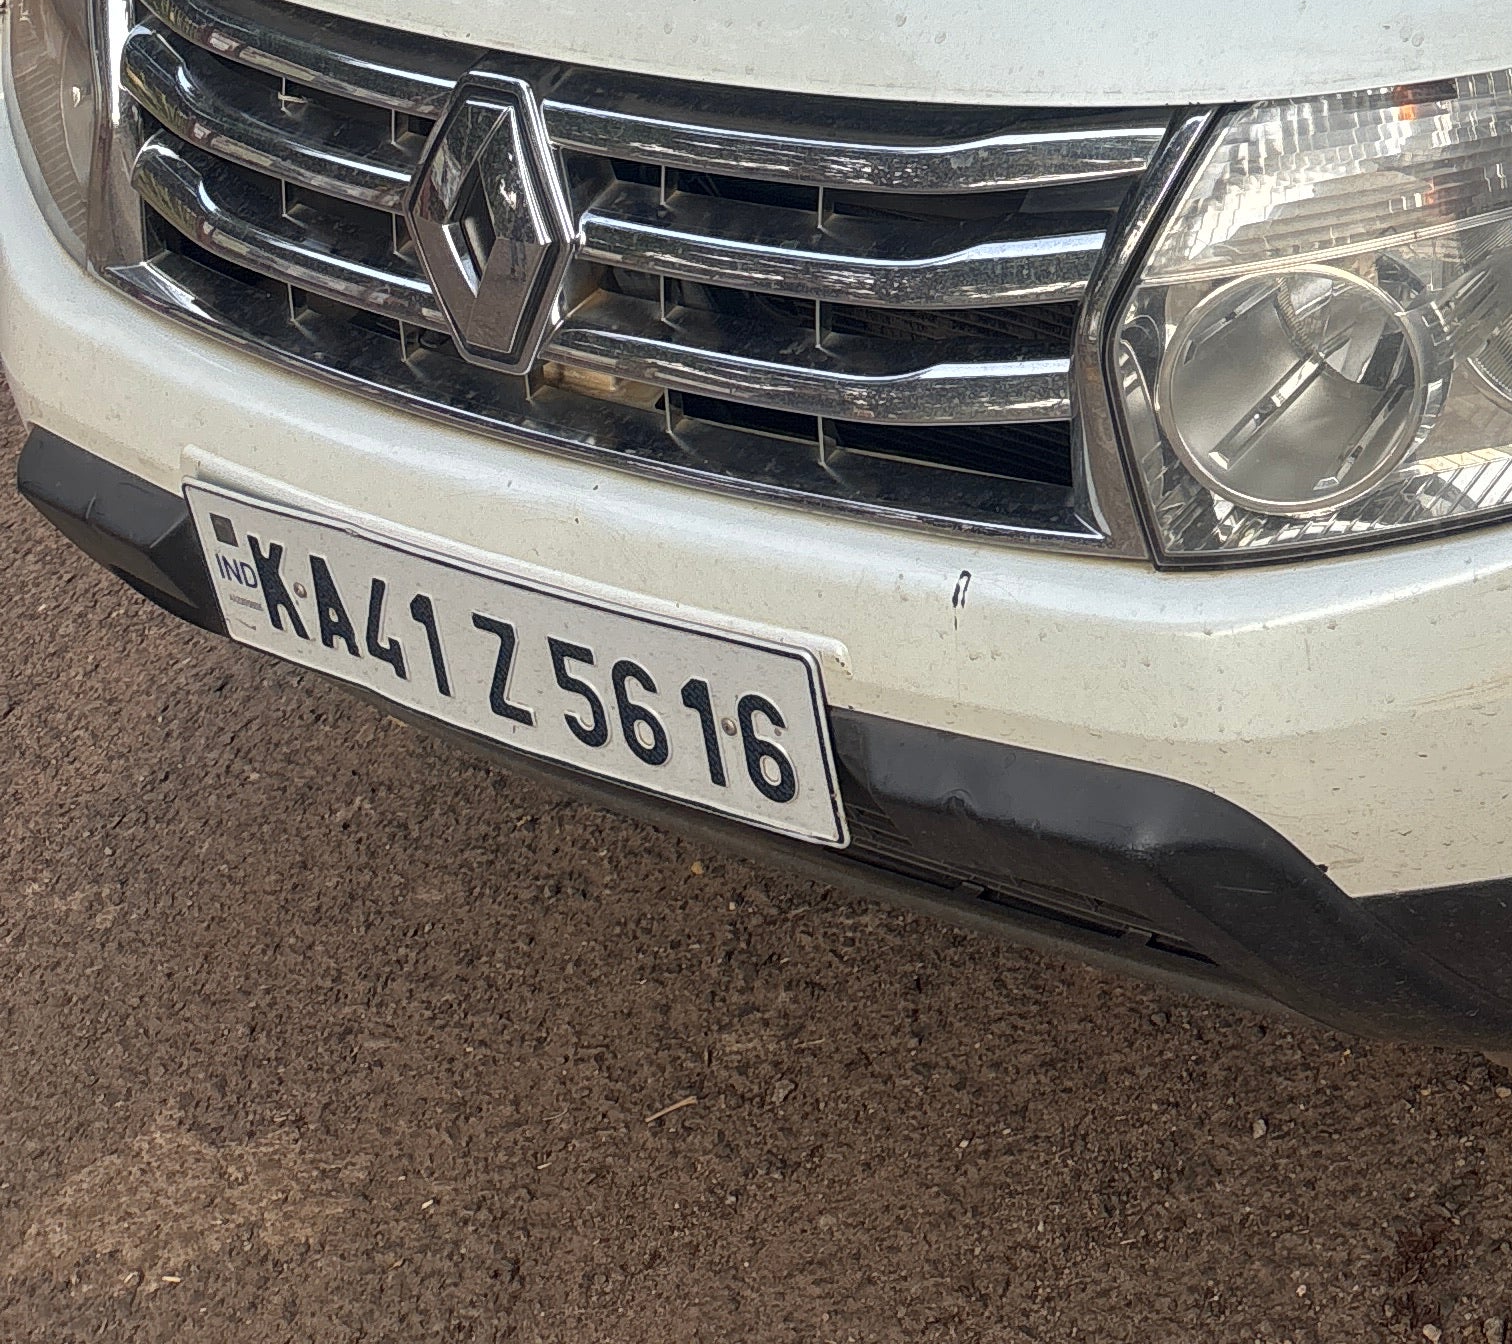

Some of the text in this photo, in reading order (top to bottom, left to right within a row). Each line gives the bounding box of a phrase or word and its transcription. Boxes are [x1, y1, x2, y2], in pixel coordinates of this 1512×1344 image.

[216, 553, 258, 588] IND
[247, 534, 797, 803] KA41 Z 5616
